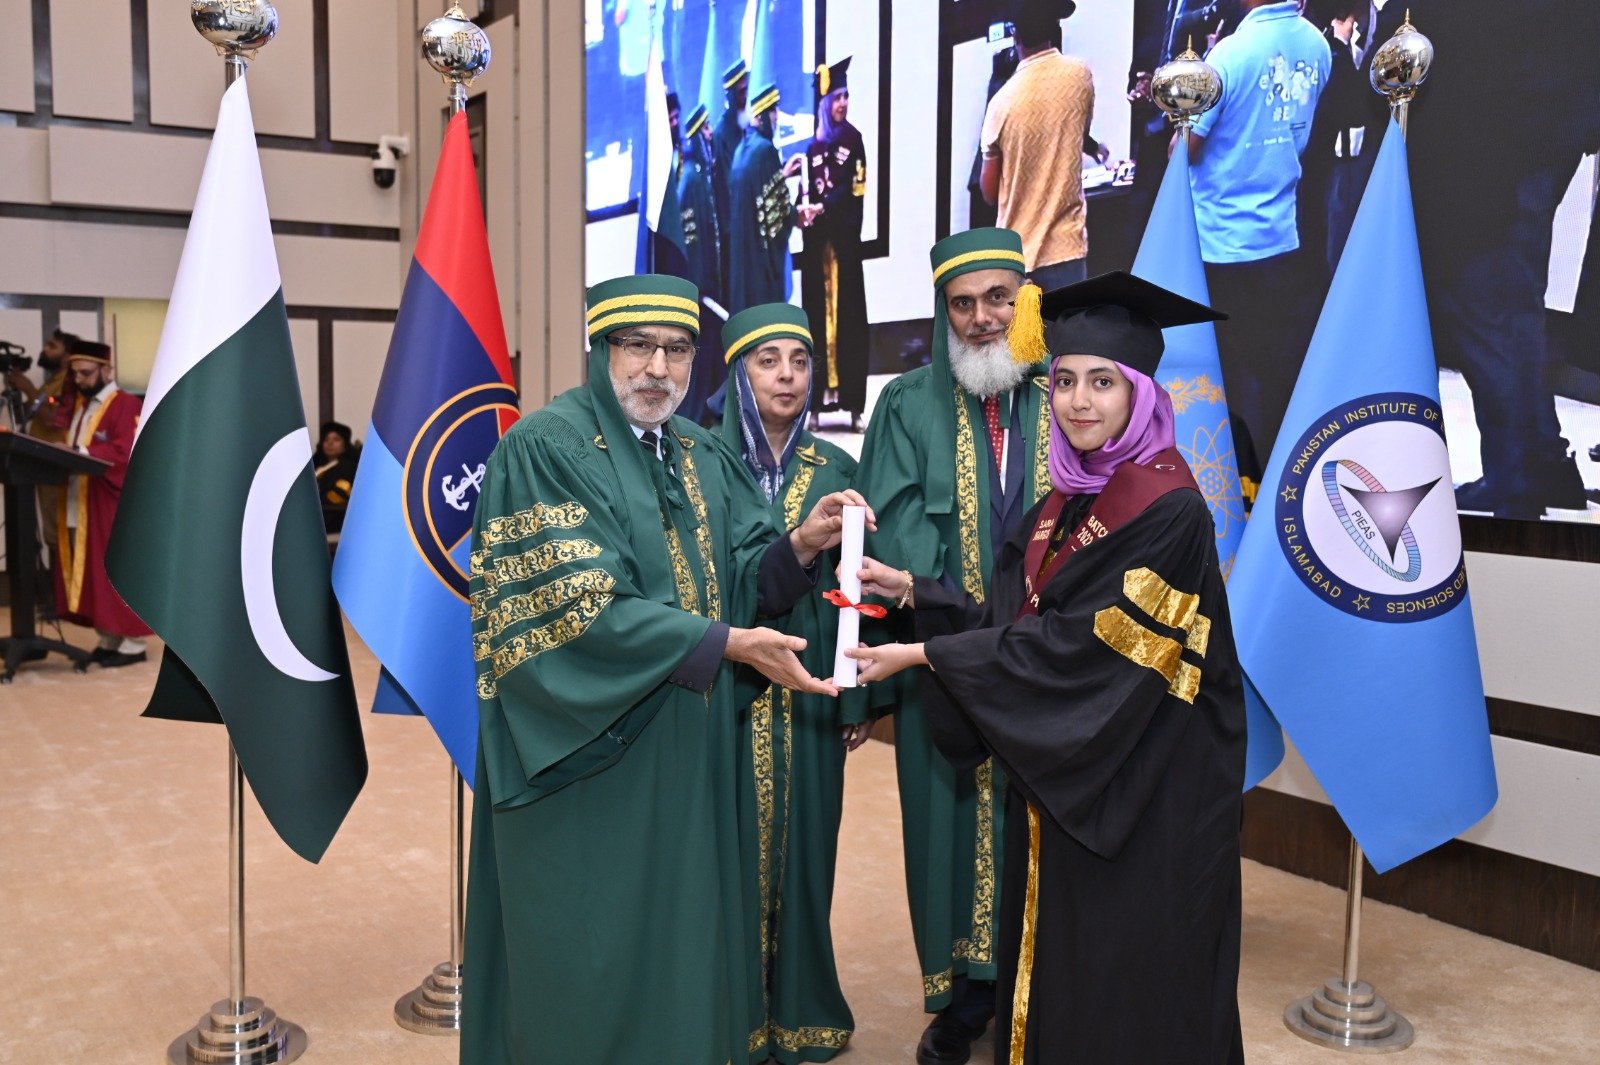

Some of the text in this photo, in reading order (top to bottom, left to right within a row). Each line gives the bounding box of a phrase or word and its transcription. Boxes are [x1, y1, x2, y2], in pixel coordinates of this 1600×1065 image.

[1292, 402, 1439, 475] PAKISTAN INSTITUTE OF
[1087, 515, 1108, 537] BATC
[1351, 510, 1376, 540] PIEAS
[1283, 517, 1342, 598] ISLAMABAD
[1386, 586, 1455, 613] SCIENCES
